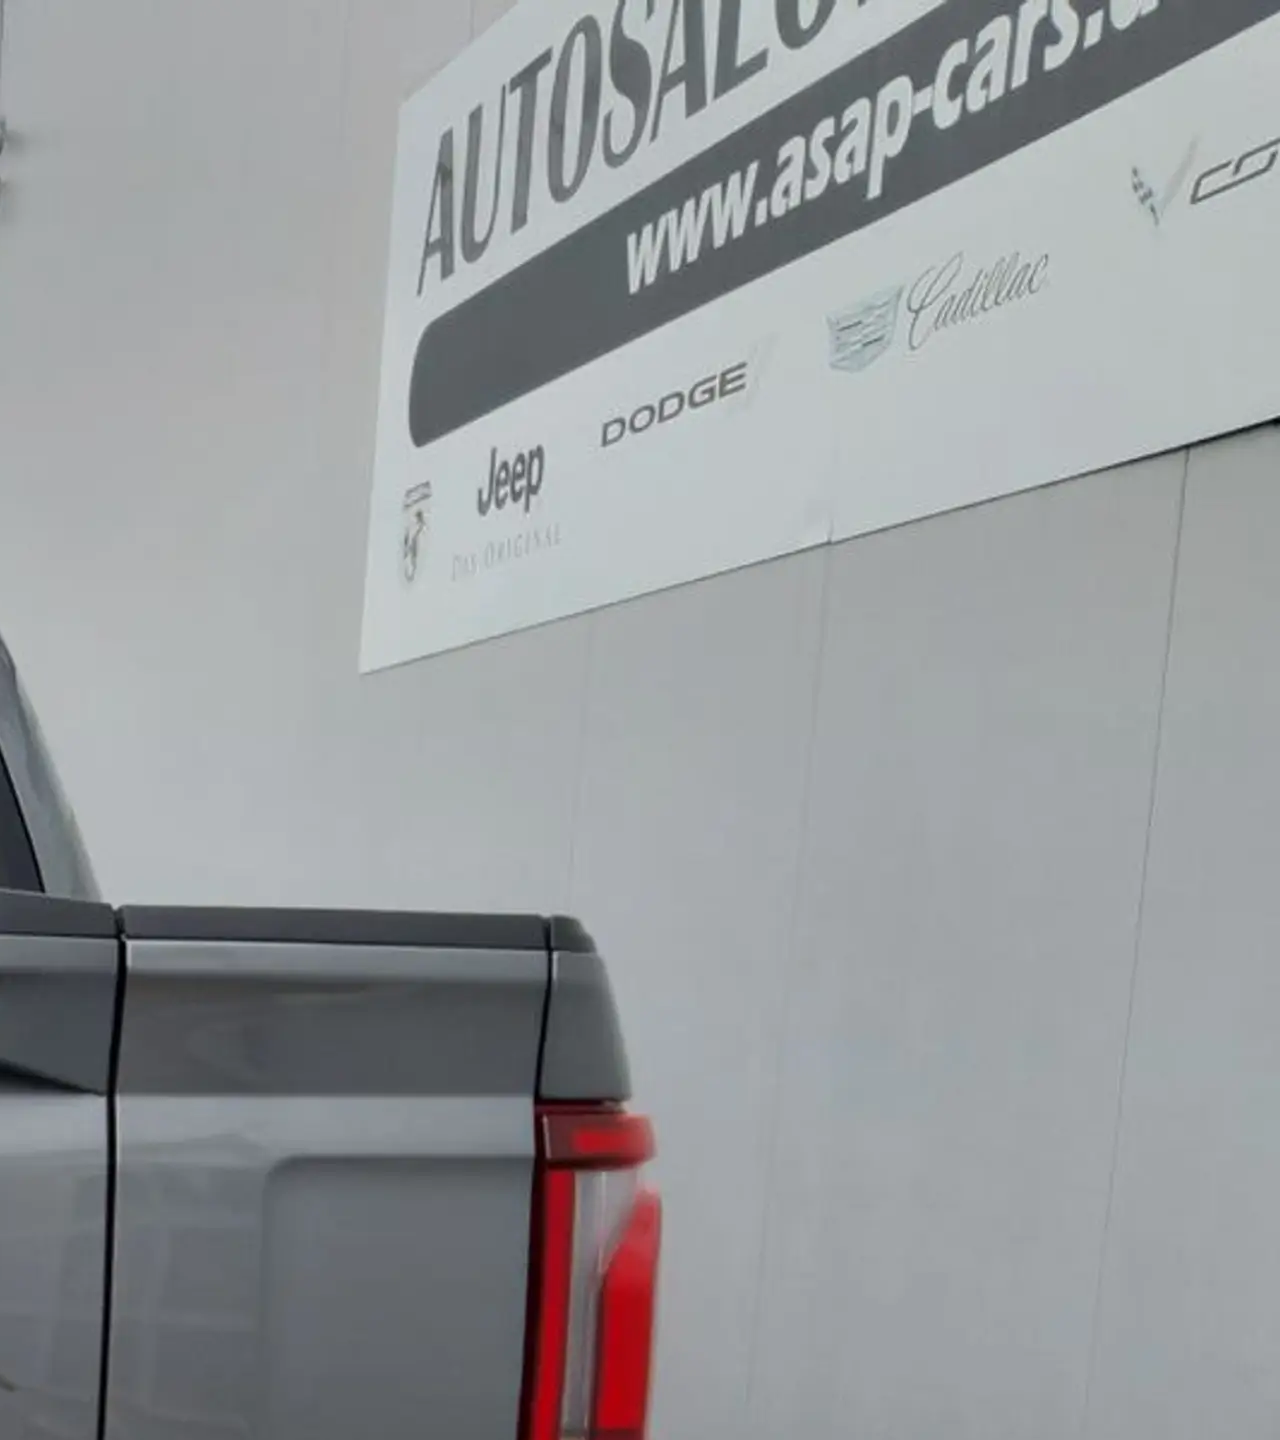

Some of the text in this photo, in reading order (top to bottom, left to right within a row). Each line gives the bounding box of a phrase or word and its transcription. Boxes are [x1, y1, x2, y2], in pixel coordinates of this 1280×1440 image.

[417, 0, 867, 296] AUTOSAL
[907, 251, 1049, 351] Cadillac
[600, 361, 748, 447] DODGE
[477, 444, 544, 517] Jeep
